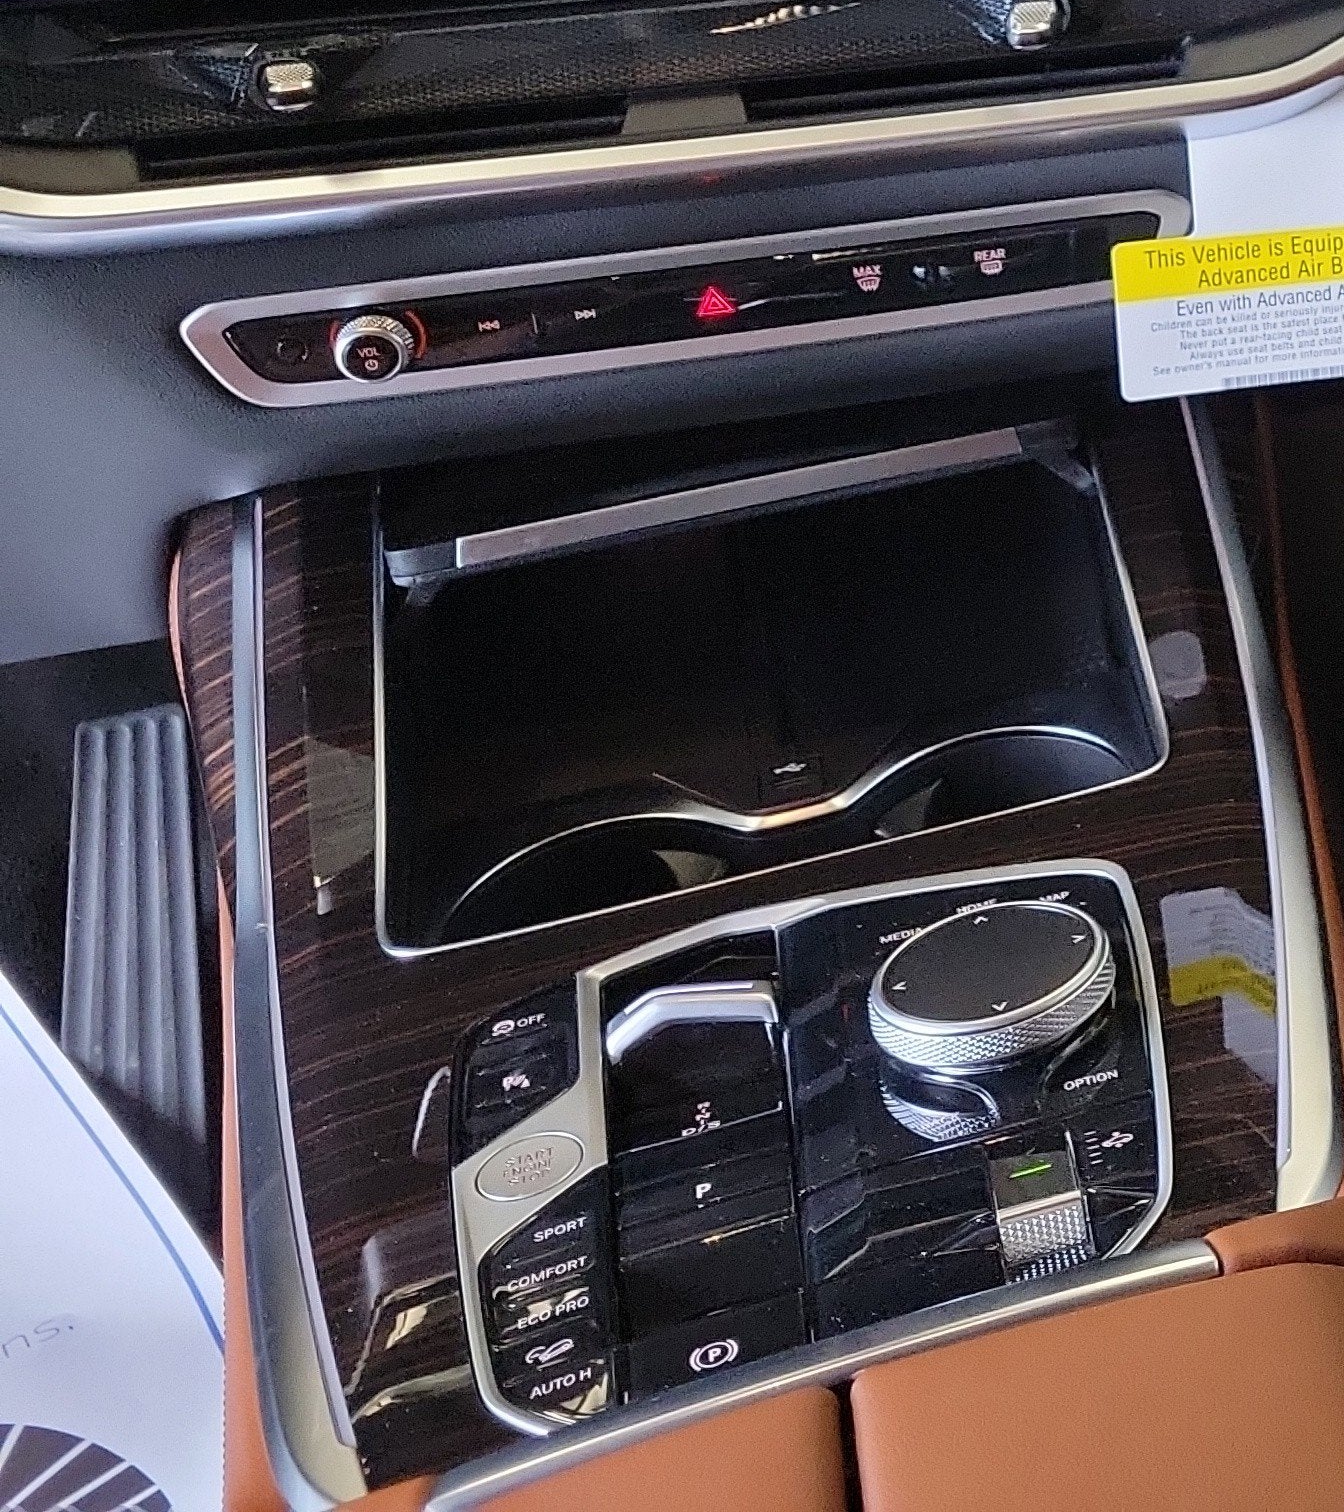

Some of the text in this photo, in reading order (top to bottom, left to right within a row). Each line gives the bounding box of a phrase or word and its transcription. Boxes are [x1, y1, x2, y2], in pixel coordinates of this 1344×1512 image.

[973, 248, 1006, 262] REAR
[1144, 248, 1185, 269] This
[1192, 241, 1261, 264] Vehicle
[1268, 239, 1284, 257] is
[852, 264, 883, 278] MAX
[1198, 261, 1290, 288] Advanced
[1298, 258, 1324, 278] Air
[1177, 300, 1214, 316] Even
[1219, 294, 1252, 312] with
[1257, 285, 1332, 308] Advanced
[1151, 320, 1193, 333] Children
[1195, 318, 1213, 327] can
[1216, 315, 1228, 325] be
[1231, 311, 1257, 322] killed
[1274, 305, 1318, 317] seriously
[1181, 329, 1198, 340] The
[1201, 327, 1224, 338] back
[1228, 324, 1248, 334] seat
[1251, 322, 1260, 331] is
[1262, 320, 1278, 330] the
[1281, 317, 1310, 328] safest
[1313, 314, 1338, 326] place
[1180, 340, 1208, 351] Never
[1212, 338, 1228, 349] put
[1230, 336, 1237, 345] a
[1296, 327, 1320, 338] child
[1322, 325, 1342, 335] seat
[1190, 349, 1224, 361] Always
[1227, 347, 1245, 356] use
[1248, 344, 1269, 354] seat
[1271, 341, 1295, 351] belts
[1298, 338, 1316, 348] and
[1318, 336, 1342, 347] child
[356, 347, 381, 358] VOL
[1153, 365, 1171, 376] See
[1174, 360, 1213, 372] owner's
[1215, 357, 1252, 368] manual
[1254, 354, 1269, 364] for
[1272, 352, 1297, 363] more
[956, 898, 998, 915] HOME
[1038, 890, 1070, 902] MAP
[879, 927, 923, 945] MEDIA
[516, 1013, 546, 1028] OFF
[1063, 1069, 1119, 1091] OPTION
[504, 1147, 554, 1168] START
[696, 1182, 711, 1199] P
[533, 1216, 587, 1243] SPORT
[507, 1255, 588, 1292] COMFORT
[517, 1295, 589, 1330] ECO PRO
[529, 1367, 592, 1399] AUTO H
